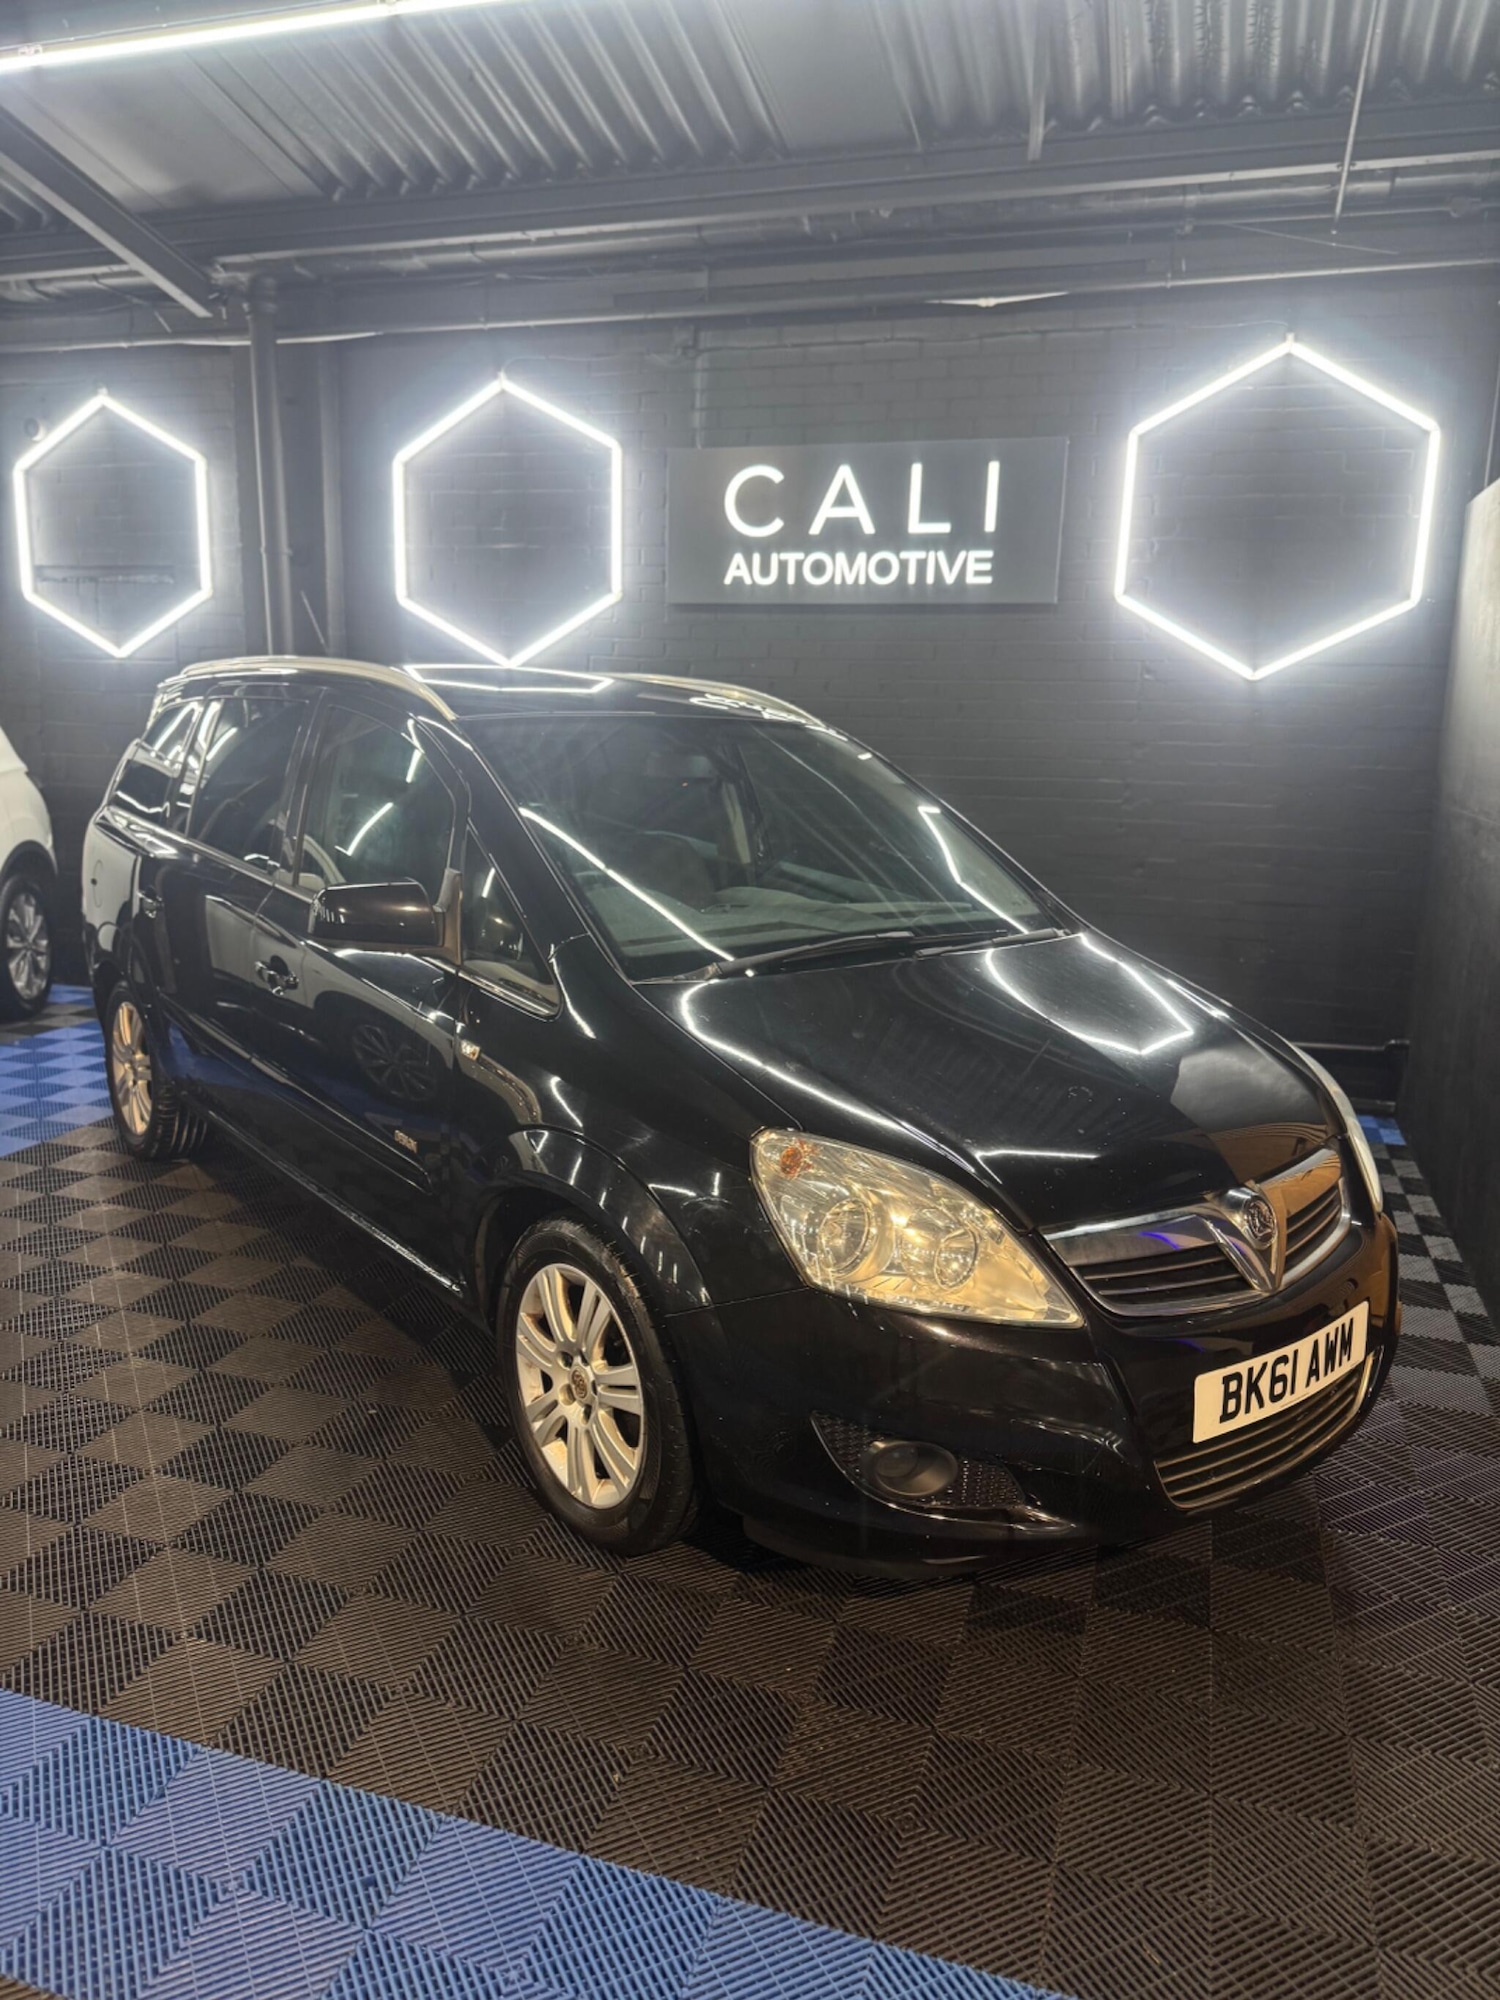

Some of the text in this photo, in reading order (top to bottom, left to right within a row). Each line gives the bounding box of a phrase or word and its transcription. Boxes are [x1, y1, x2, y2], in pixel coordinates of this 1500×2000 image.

[724, 460, 1000, 538] CALI
[723, 549, 994, 586] AUTOMOTIVE
[1219, 1317, 1355, 1424] BK61 AWM
